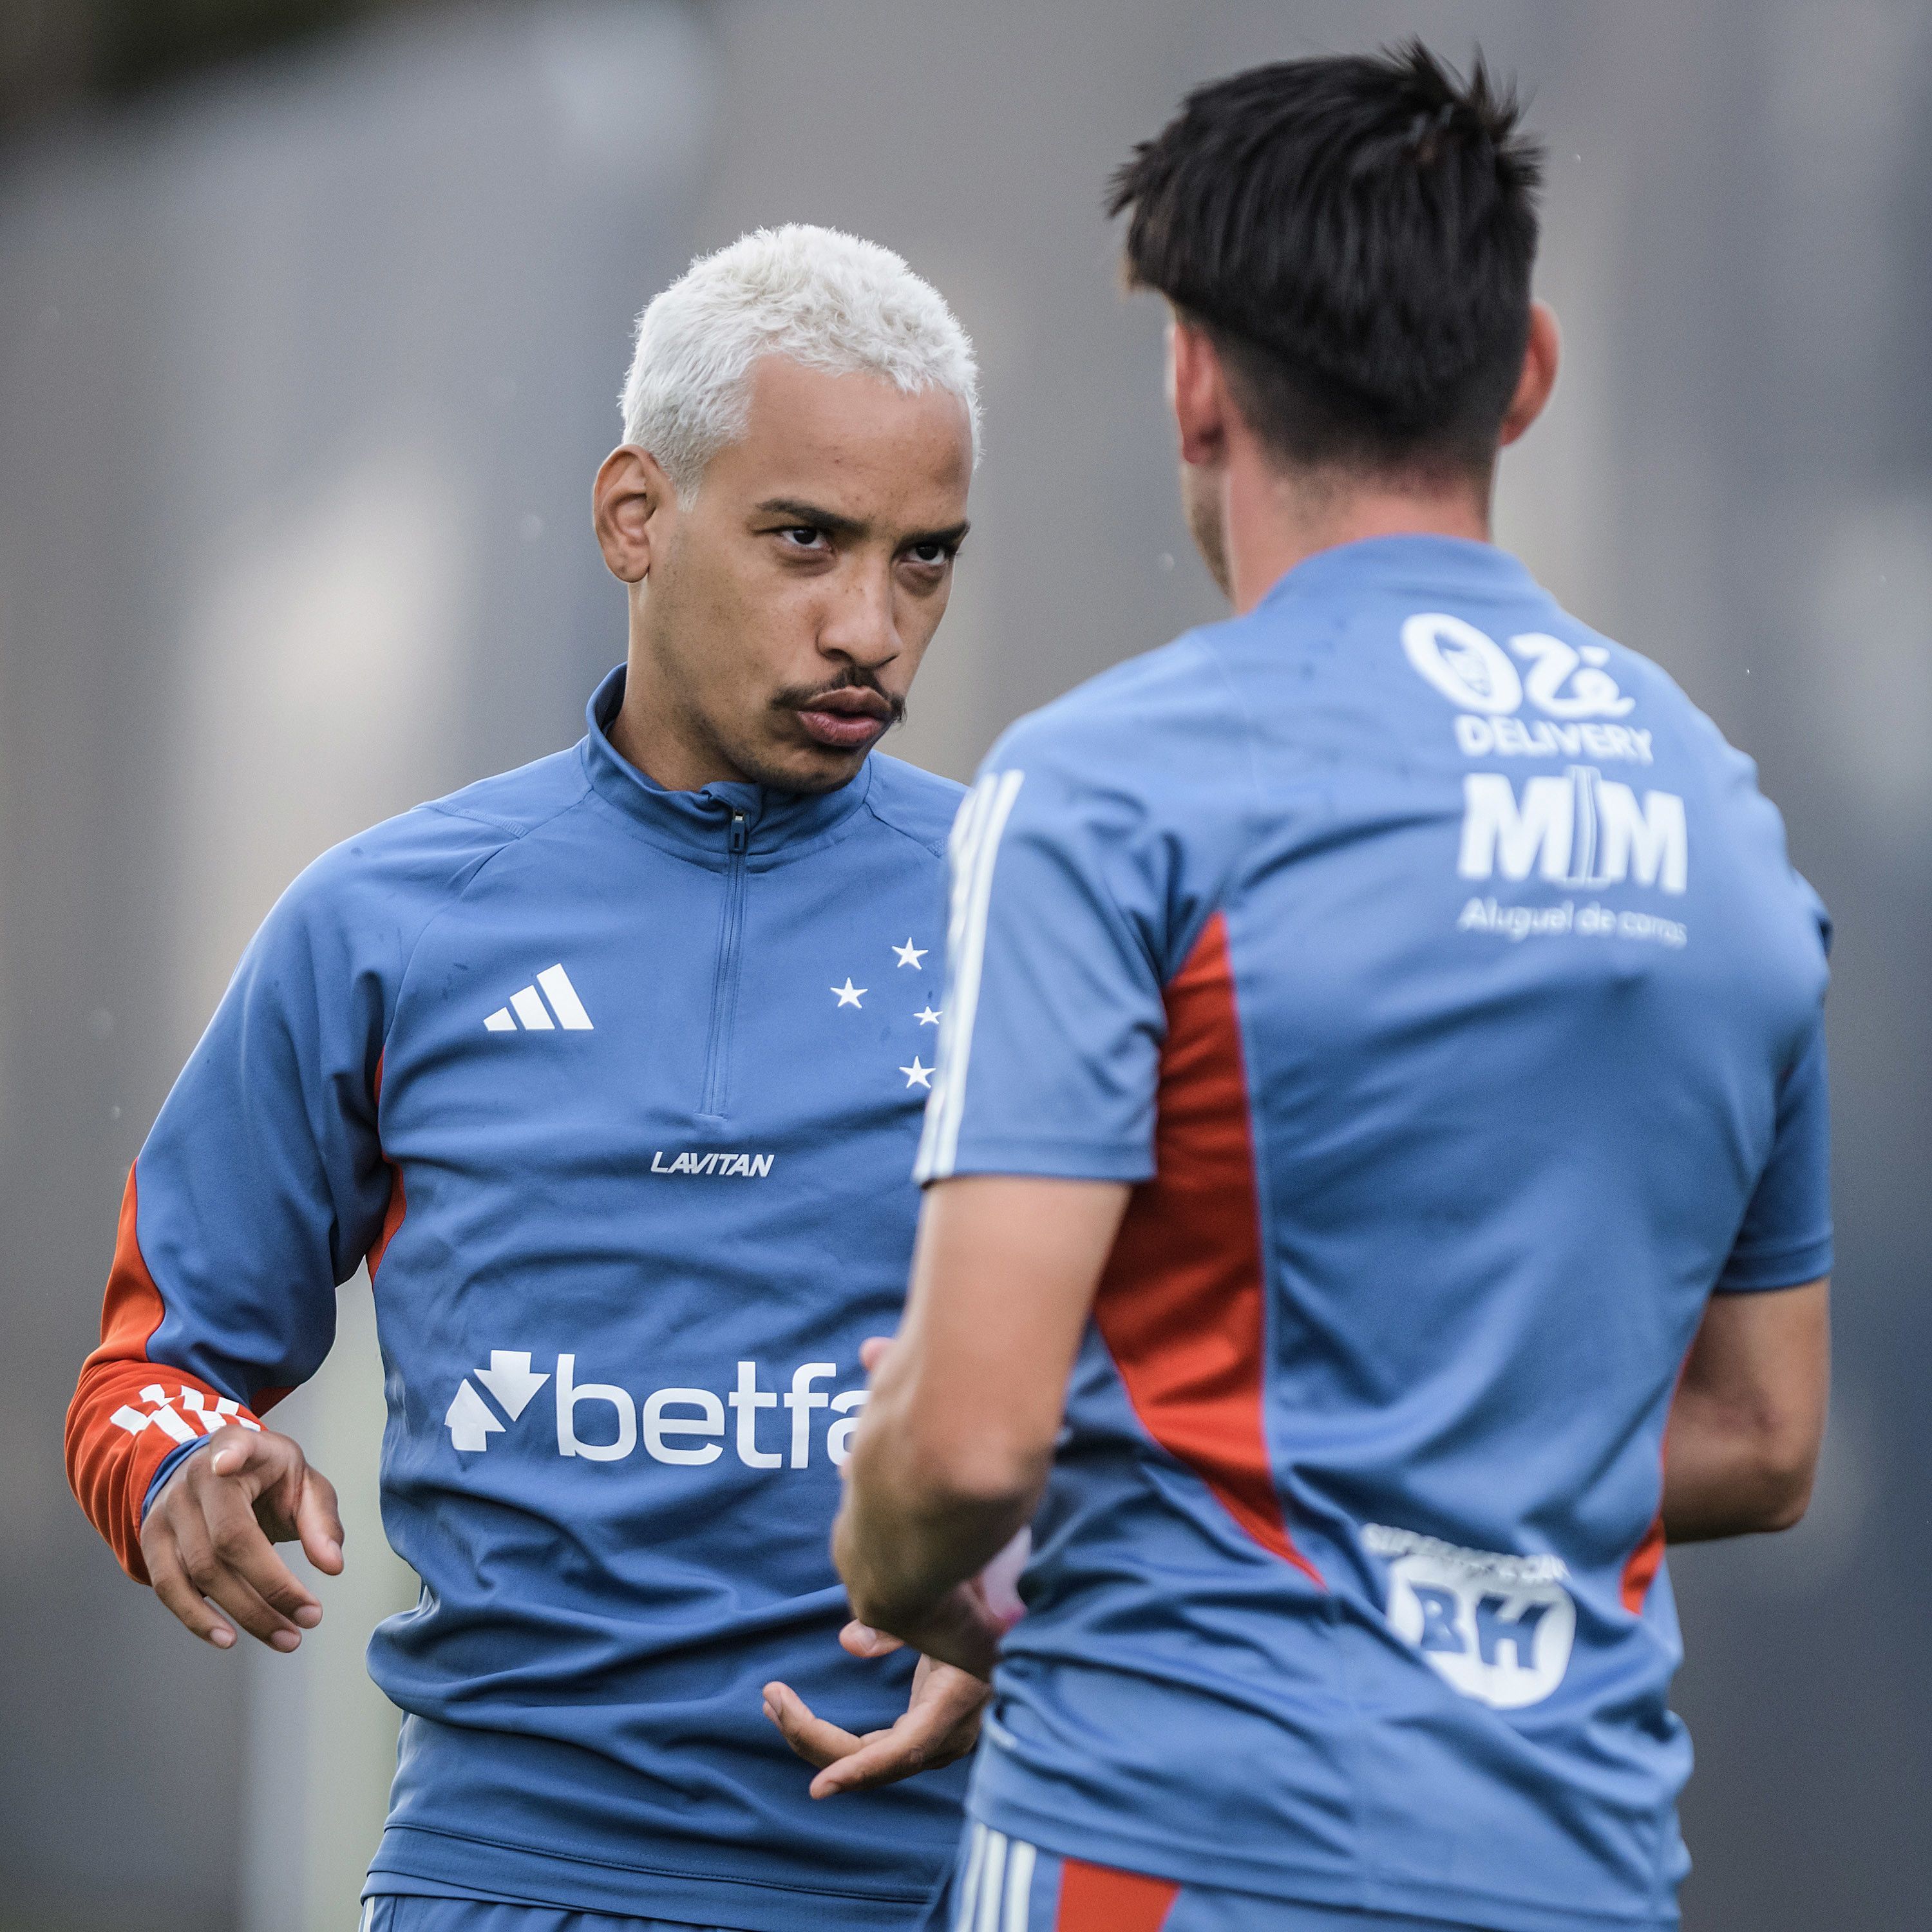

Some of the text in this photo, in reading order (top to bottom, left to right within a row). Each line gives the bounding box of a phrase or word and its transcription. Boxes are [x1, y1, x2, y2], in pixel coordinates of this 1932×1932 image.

[1454, 714, 1654, 765] DELIVERY
[1458, 896, 1575, 942] Aluguel
[1575, 900, 1617, 933] de
[650, 1151, 775, 1177] LAVITAN
